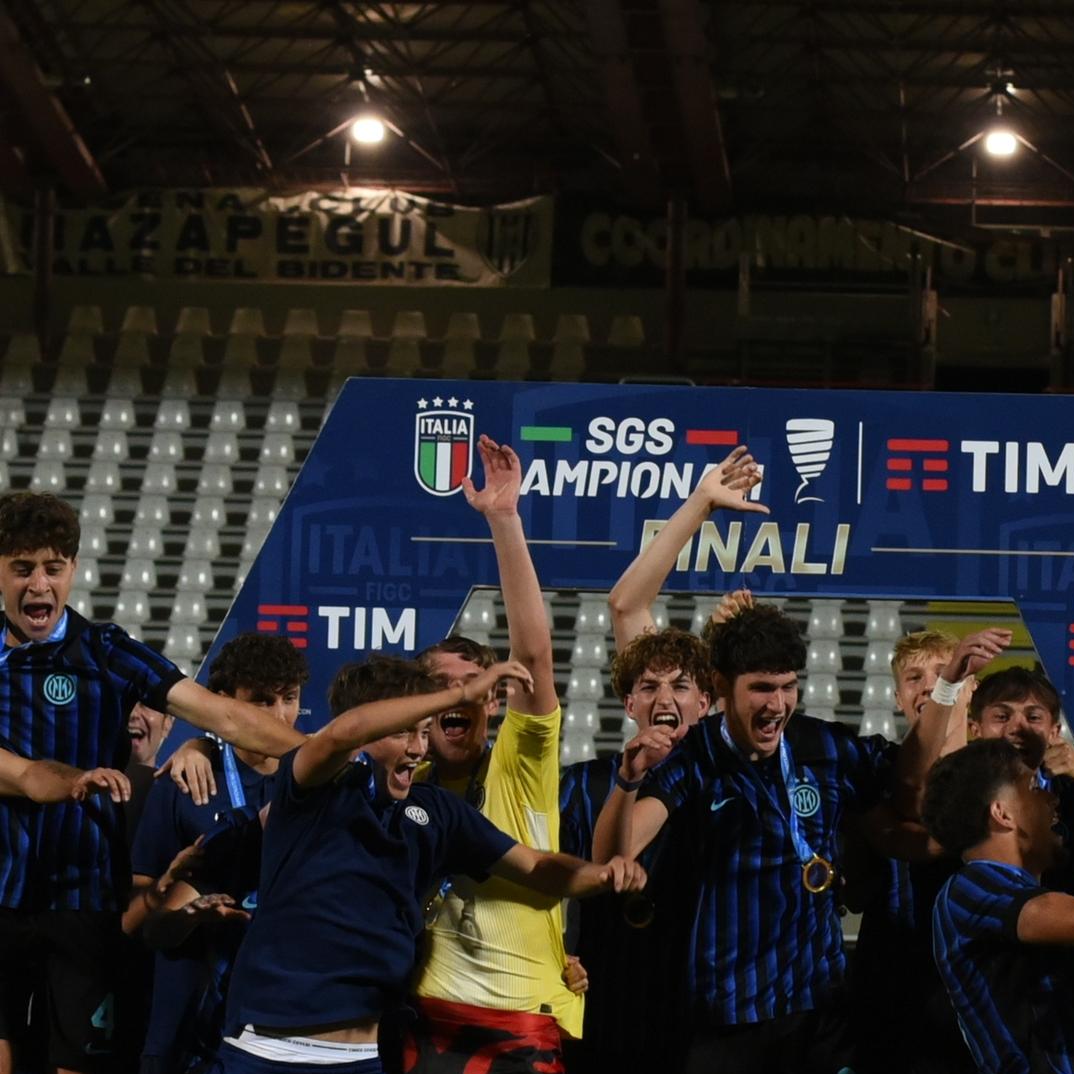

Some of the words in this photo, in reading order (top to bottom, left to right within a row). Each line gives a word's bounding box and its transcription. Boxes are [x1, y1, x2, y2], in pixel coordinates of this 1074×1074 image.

[28, 256, 153, 277] ALLE
[175, 257, 257, 279] DEL
[277, 258, 460, 281] BIDENTE
[420, 418, 469, 435] ITALIA
[585, 416, 675, 456] SGS
[519, 458, 765, 501] AMPIONI
[307, 523, 474, 577] ITALIA
[365, 582, 413, 601] FIGC
[318, 605, 417, 651] TIM
[90, 991, 117, 1041] 4
